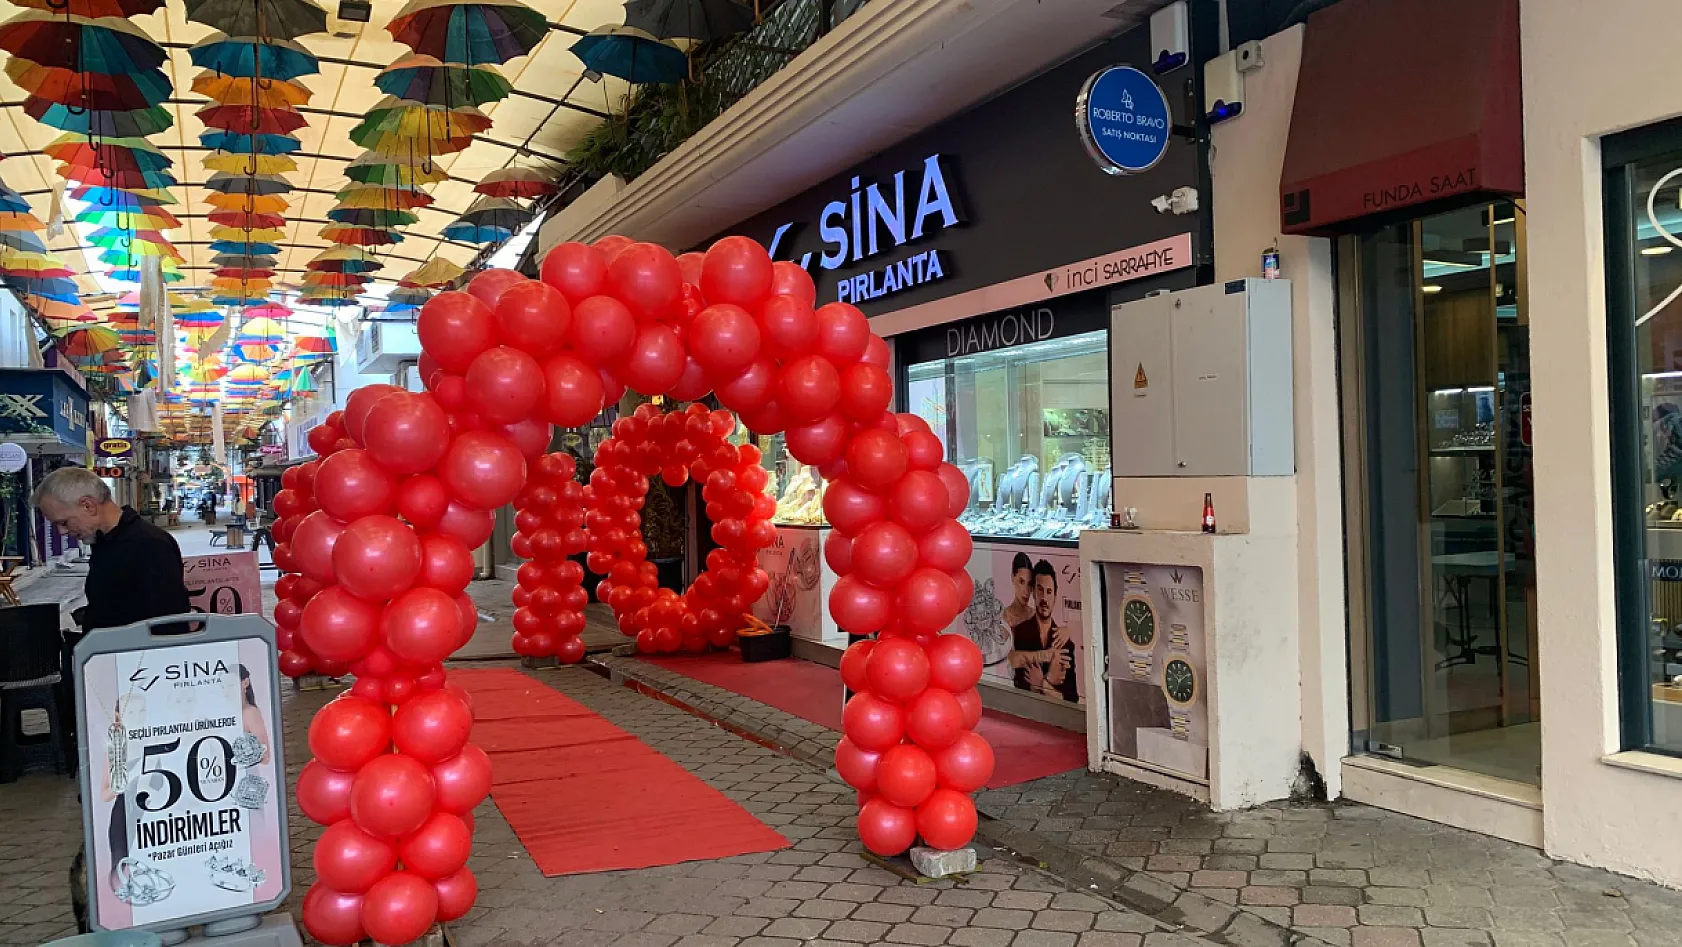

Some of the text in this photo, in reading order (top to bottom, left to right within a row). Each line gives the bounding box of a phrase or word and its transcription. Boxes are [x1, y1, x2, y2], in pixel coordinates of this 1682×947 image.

[1093, 107, 1165, 129] ROBERTO BRAVO
[1102, 127, 1157, 143] SATIŞ NOKTASI
[1362, 168, 1476, 209] FUNDA SAAT
[819, 153, 959, 270] SİNA
[837, 249, 943, 304] PIRLANTA
[1067, 262, 1098, 289] inci
[946, 308, 1055, 357] DIAMOND
[103, 441, 128, 450] gratis
[1652, 565, 1682, 578] MO
[1159, 586, 1200, 603] WESSE
[165, 660, 229, 680] SİNA
[173, 678, 222, 689] PIRLANTA
[128, 716, 237, 741] SEÇİLİ PIRLANTALI ÜRÜNLERDE
[135, 735, 237, 812] 50
[136, 808, 242, 850] İNDİRİMLER
[176, 842, 207, 857] Günleri
